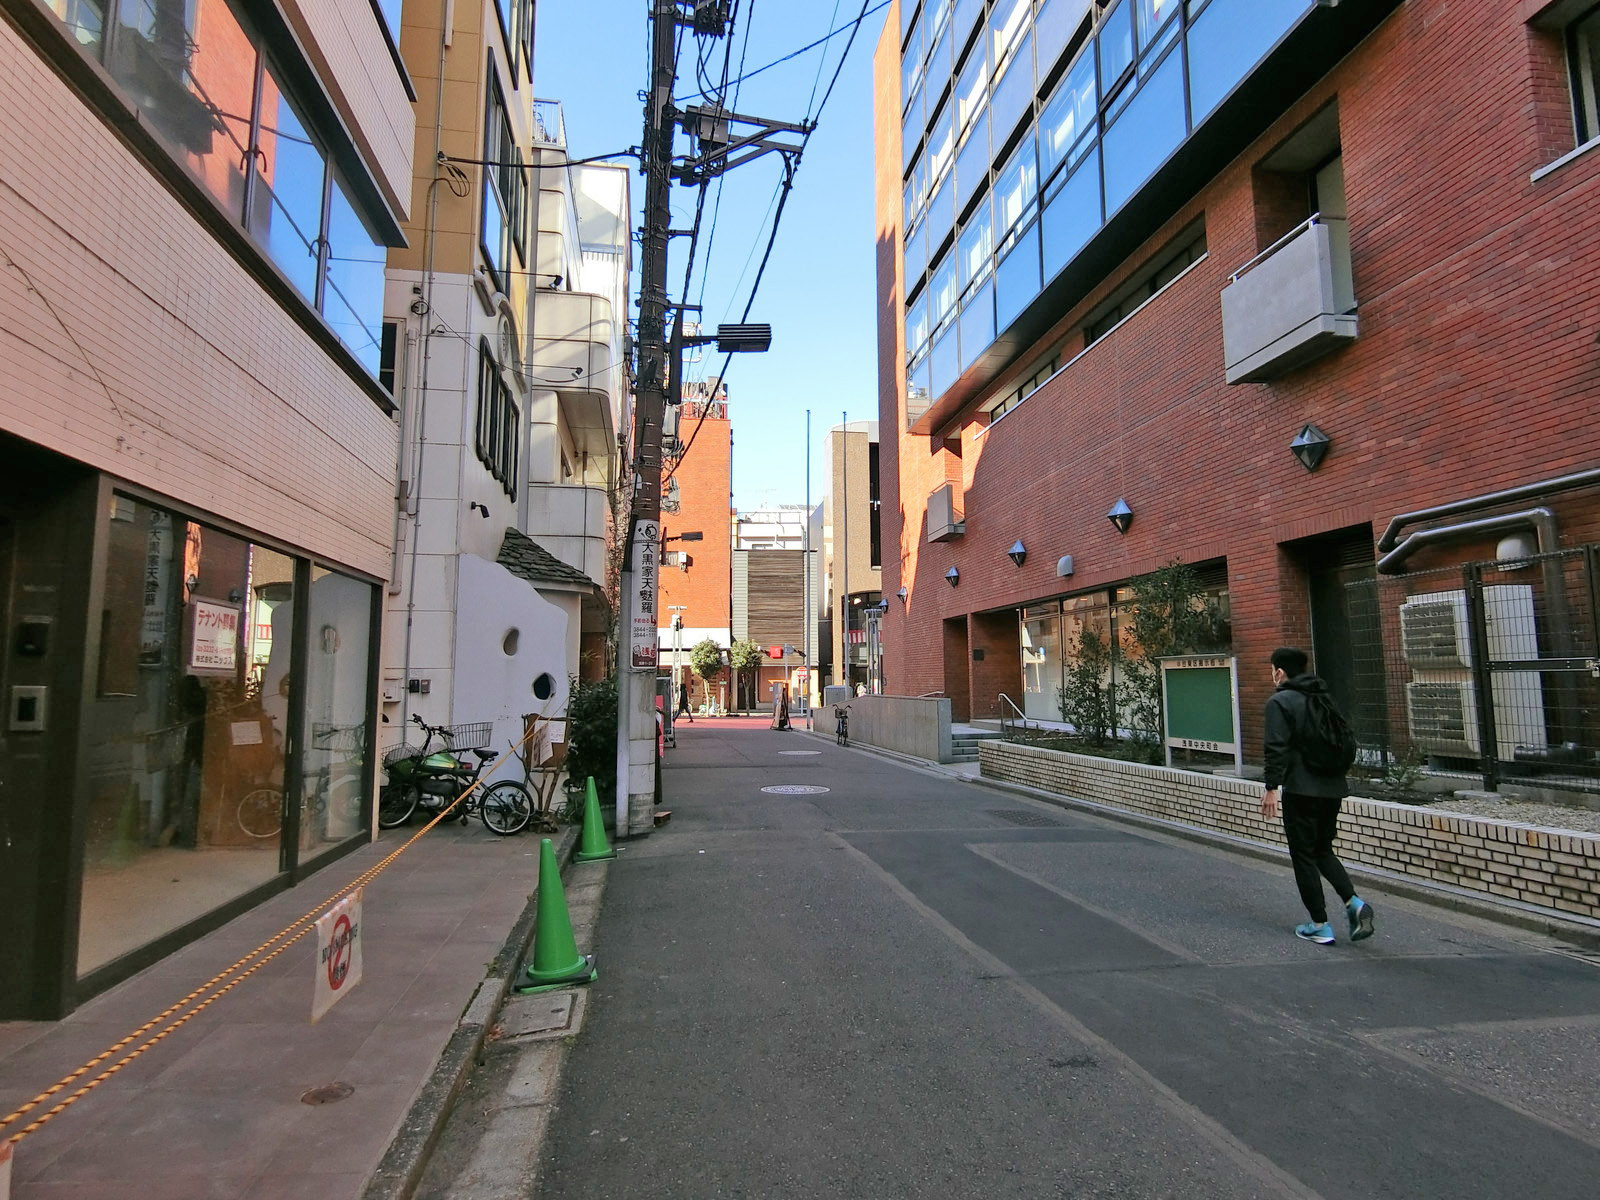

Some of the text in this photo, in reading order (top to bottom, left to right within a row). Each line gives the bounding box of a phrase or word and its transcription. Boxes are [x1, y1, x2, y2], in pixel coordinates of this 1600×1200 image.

[639, 543, 654, 614] 大黒家天麩羅
[198, 610, 236, 630] テナント募集
[1182, 739, 1218, 751] 浅草中央町会
